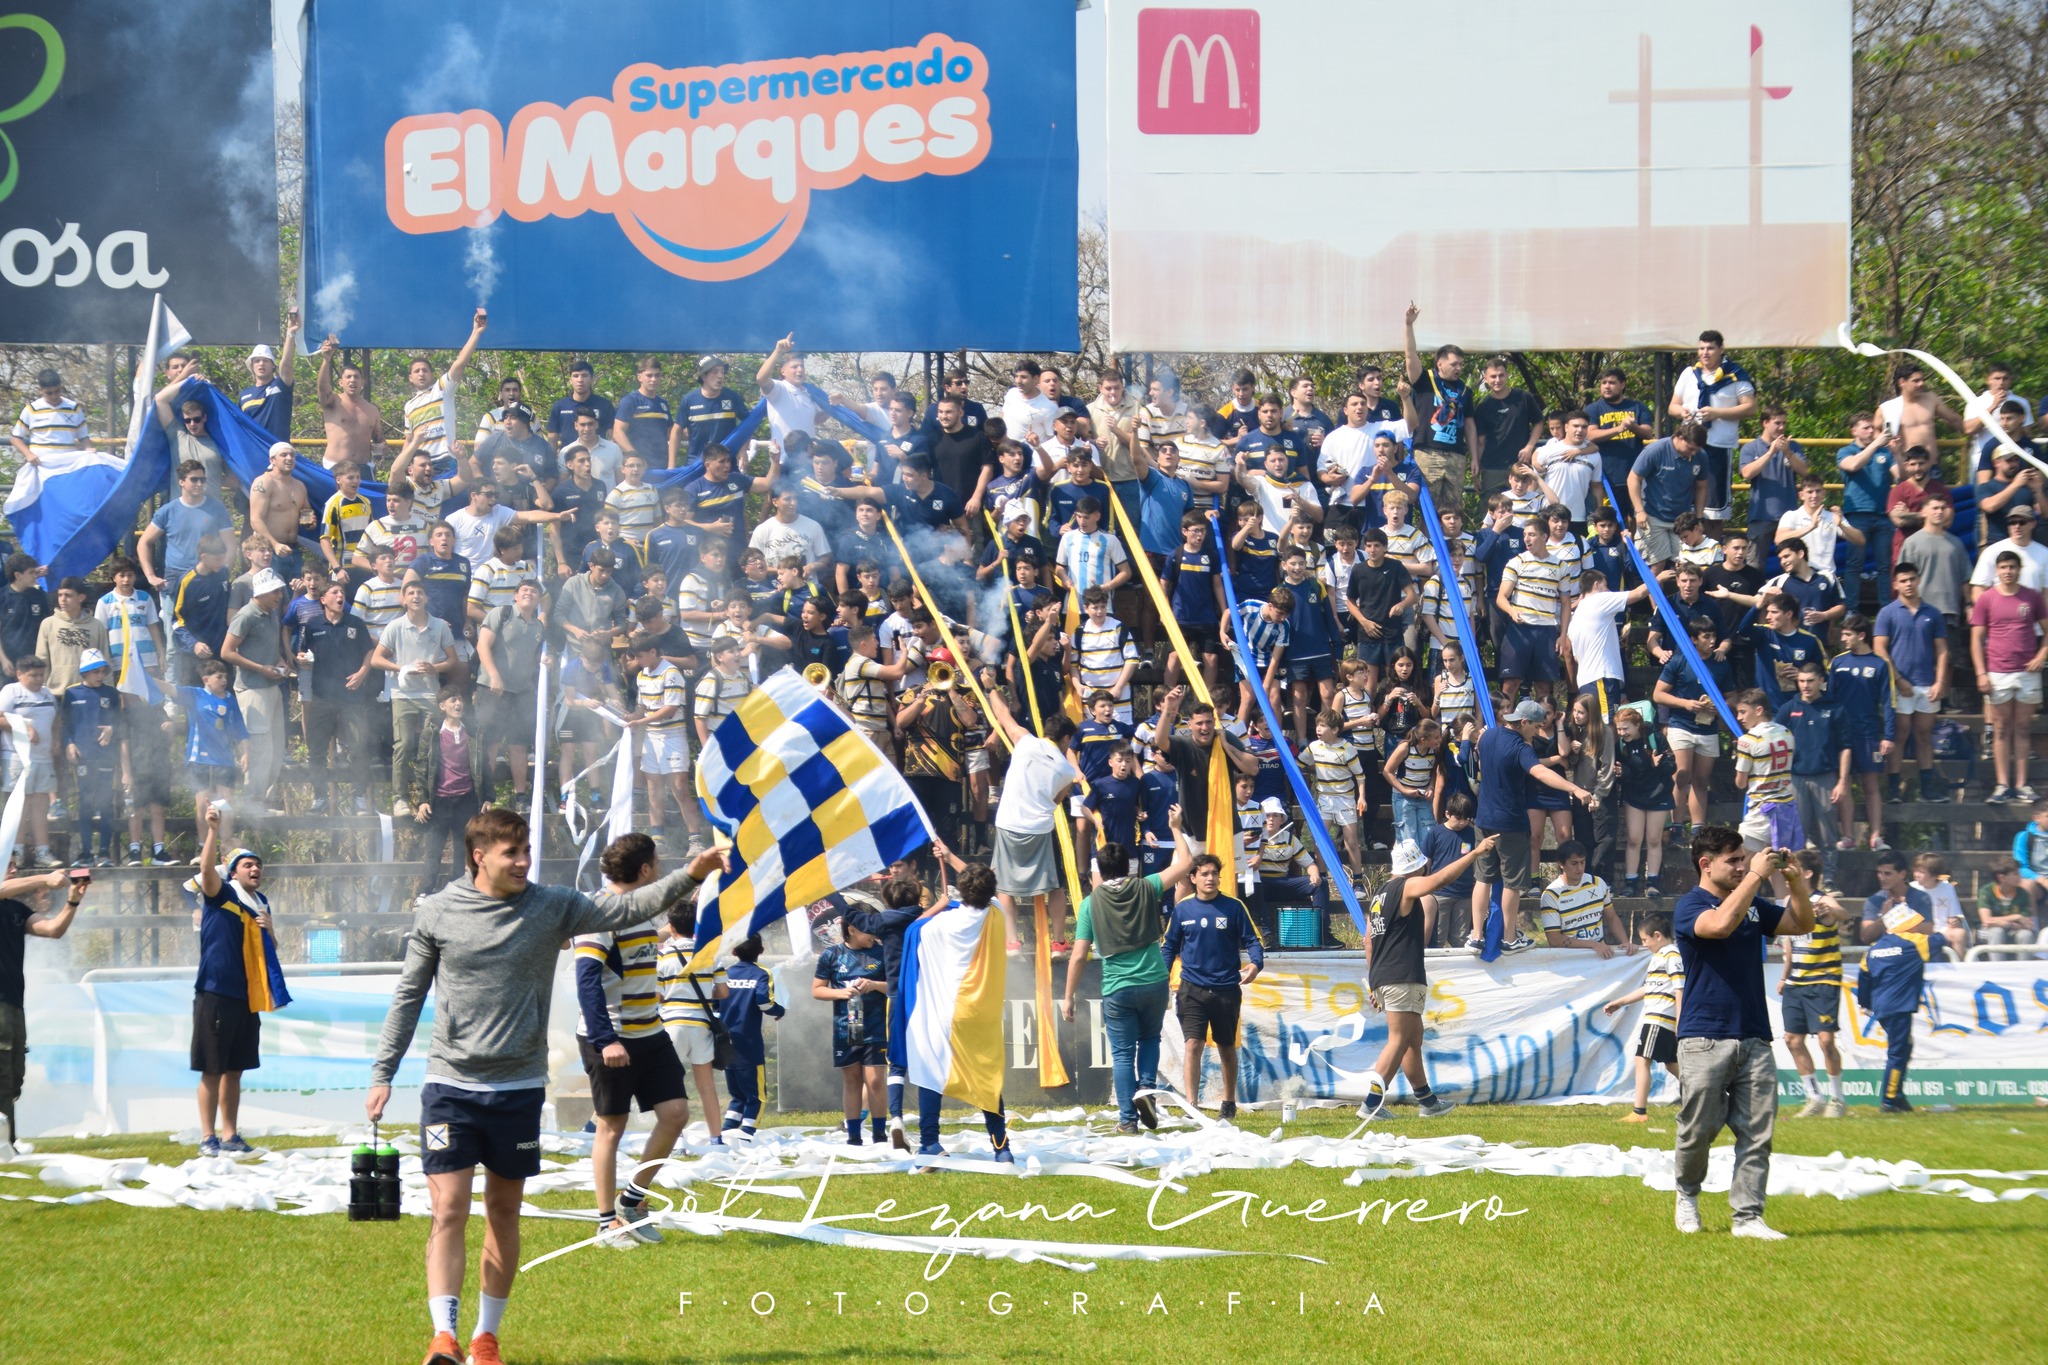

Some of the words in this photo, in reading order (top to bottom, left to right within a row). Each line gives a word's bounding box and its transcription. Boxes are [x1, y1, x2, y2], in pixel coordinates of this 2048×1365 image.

[629, 46, 973, 119] Supermercado
[402, 123, 491, 217] El
[516, 96, 978, 205] Marques
[0, 221, 169, 289] osa
[1079, 552, 1089, 562] 10
[1769, 740, 1788, 770] 13
[1922, 1080, 1945, 1096] 851
